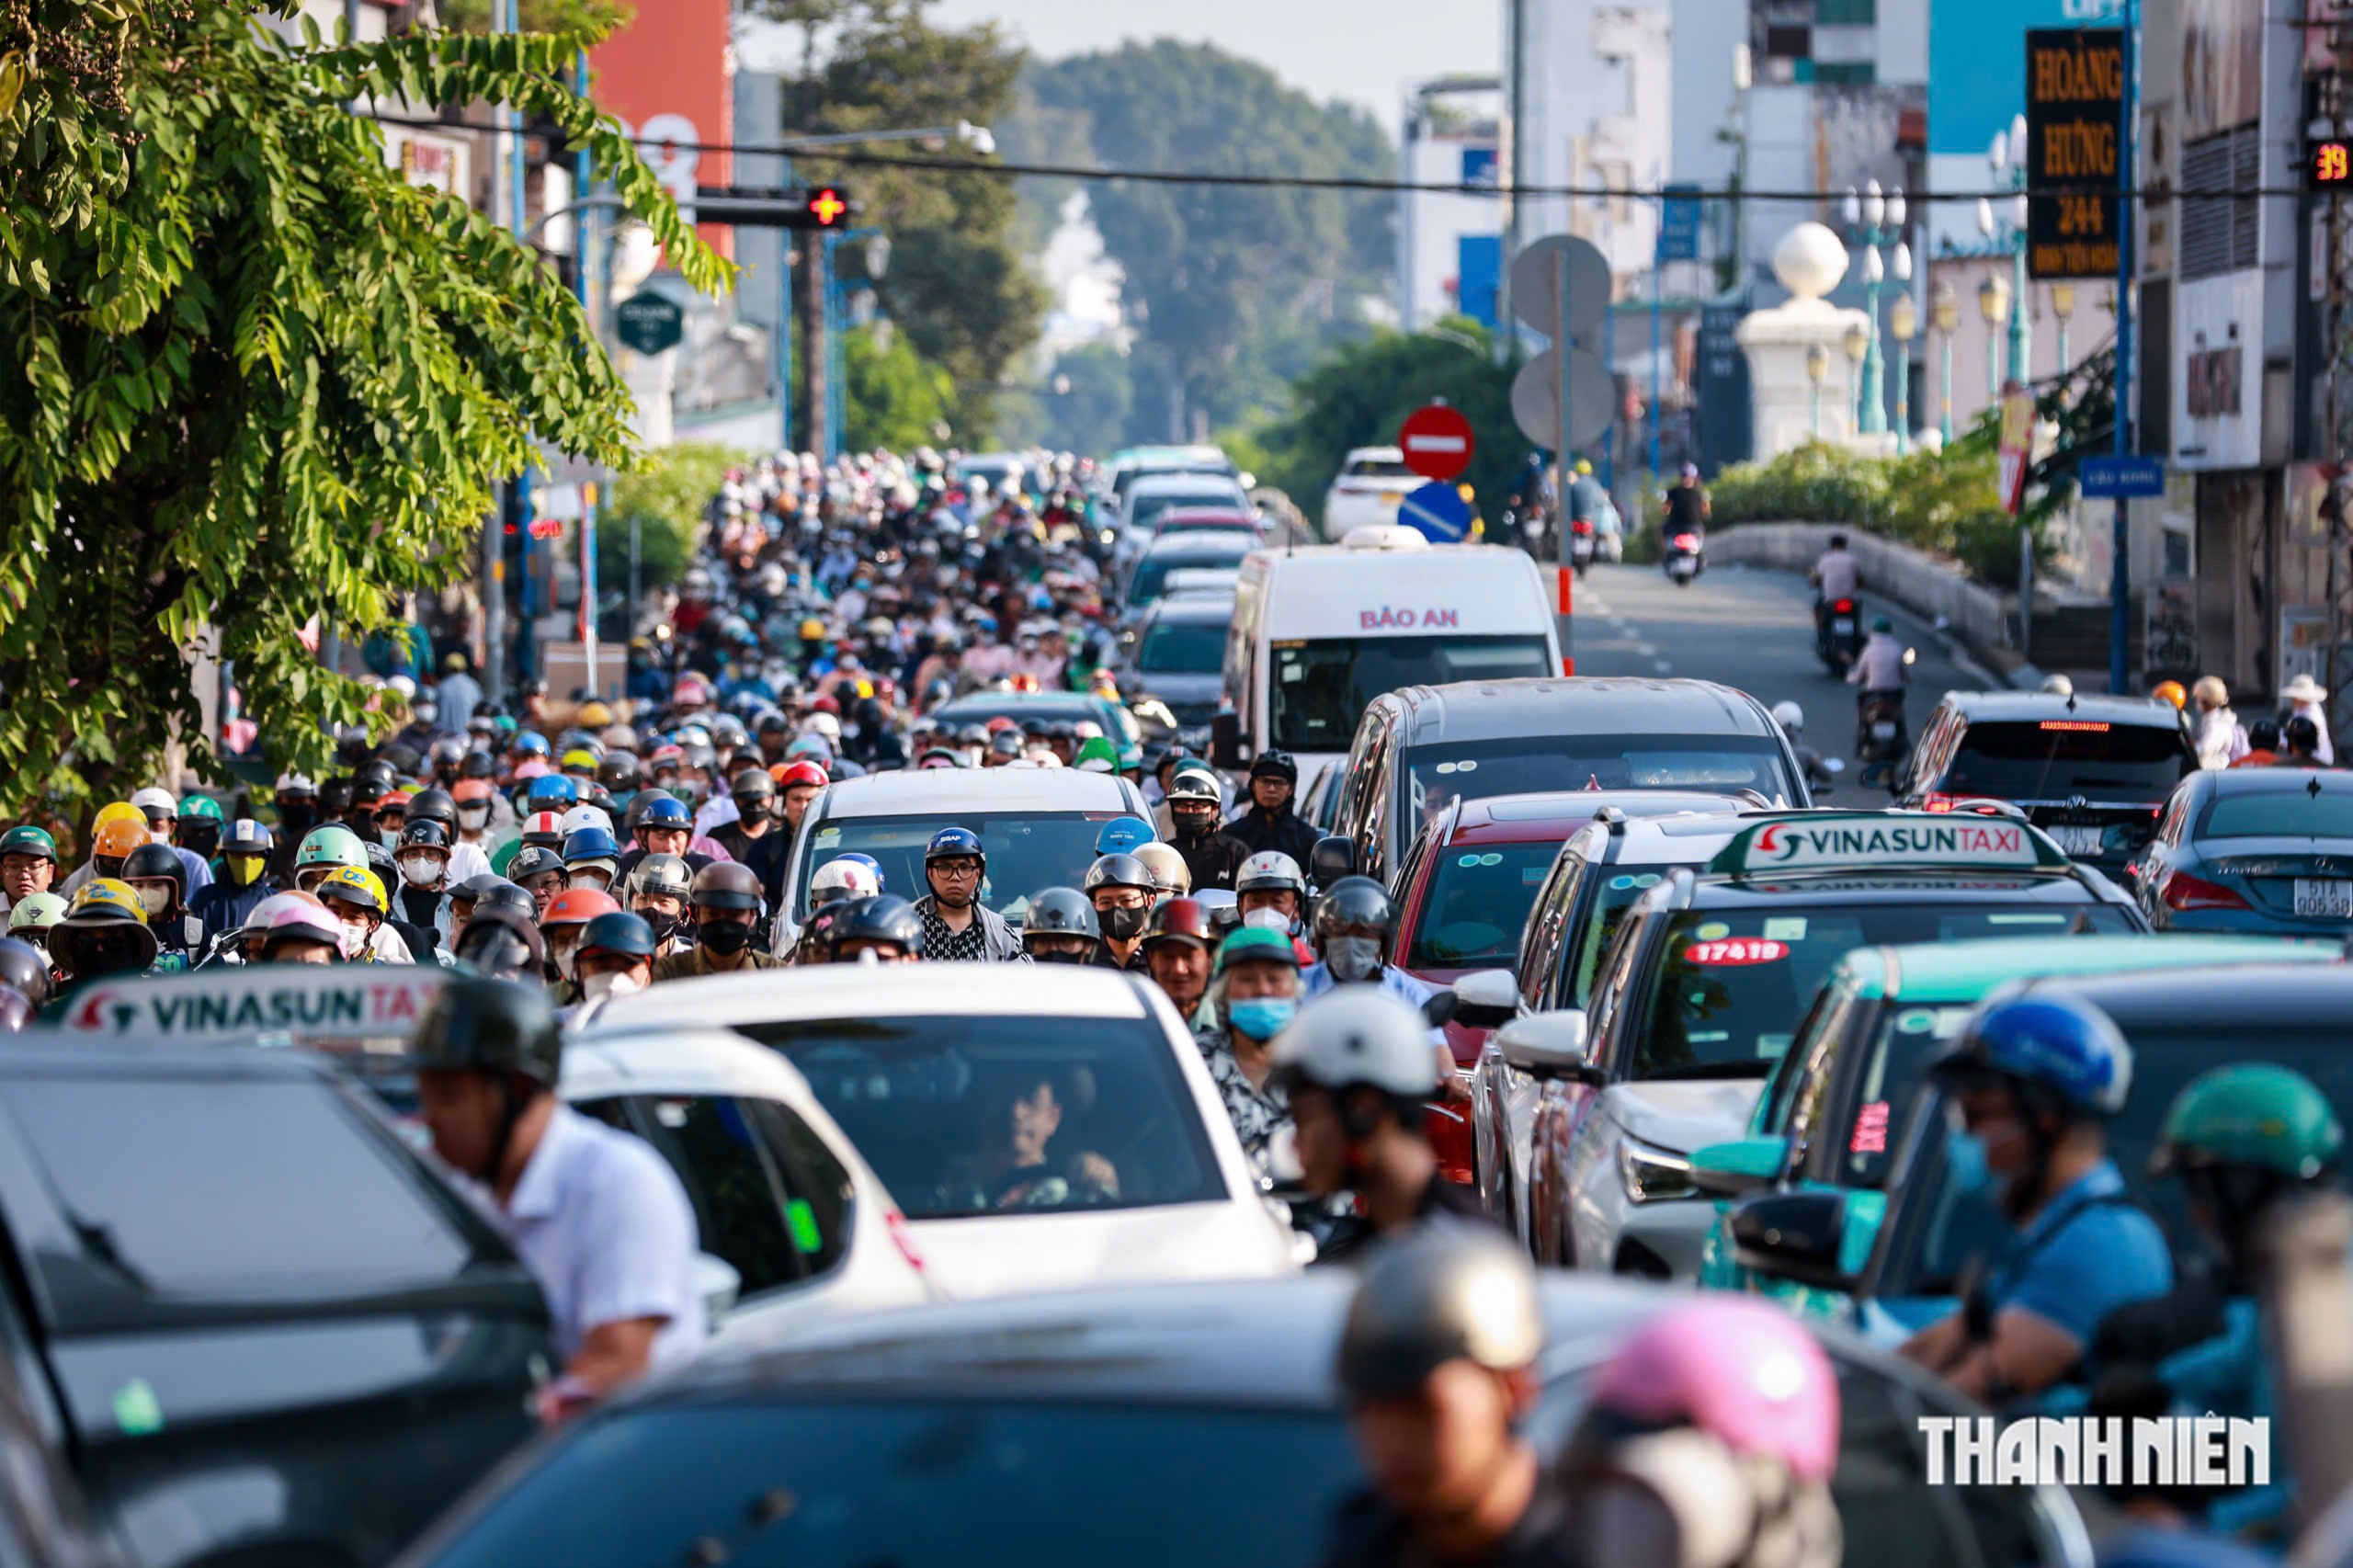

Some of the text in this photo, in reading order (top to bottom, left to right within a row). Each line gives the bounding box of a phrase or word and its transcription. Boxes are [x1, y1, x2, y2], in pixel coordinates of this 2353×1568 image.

[2317, 143, 2347, 180] 39
[2057, 187, 2103, 234] 244
[1359, 606, 1459, 630] BẢO AN
[151, 983, 434, 1033] VINASUNTA
